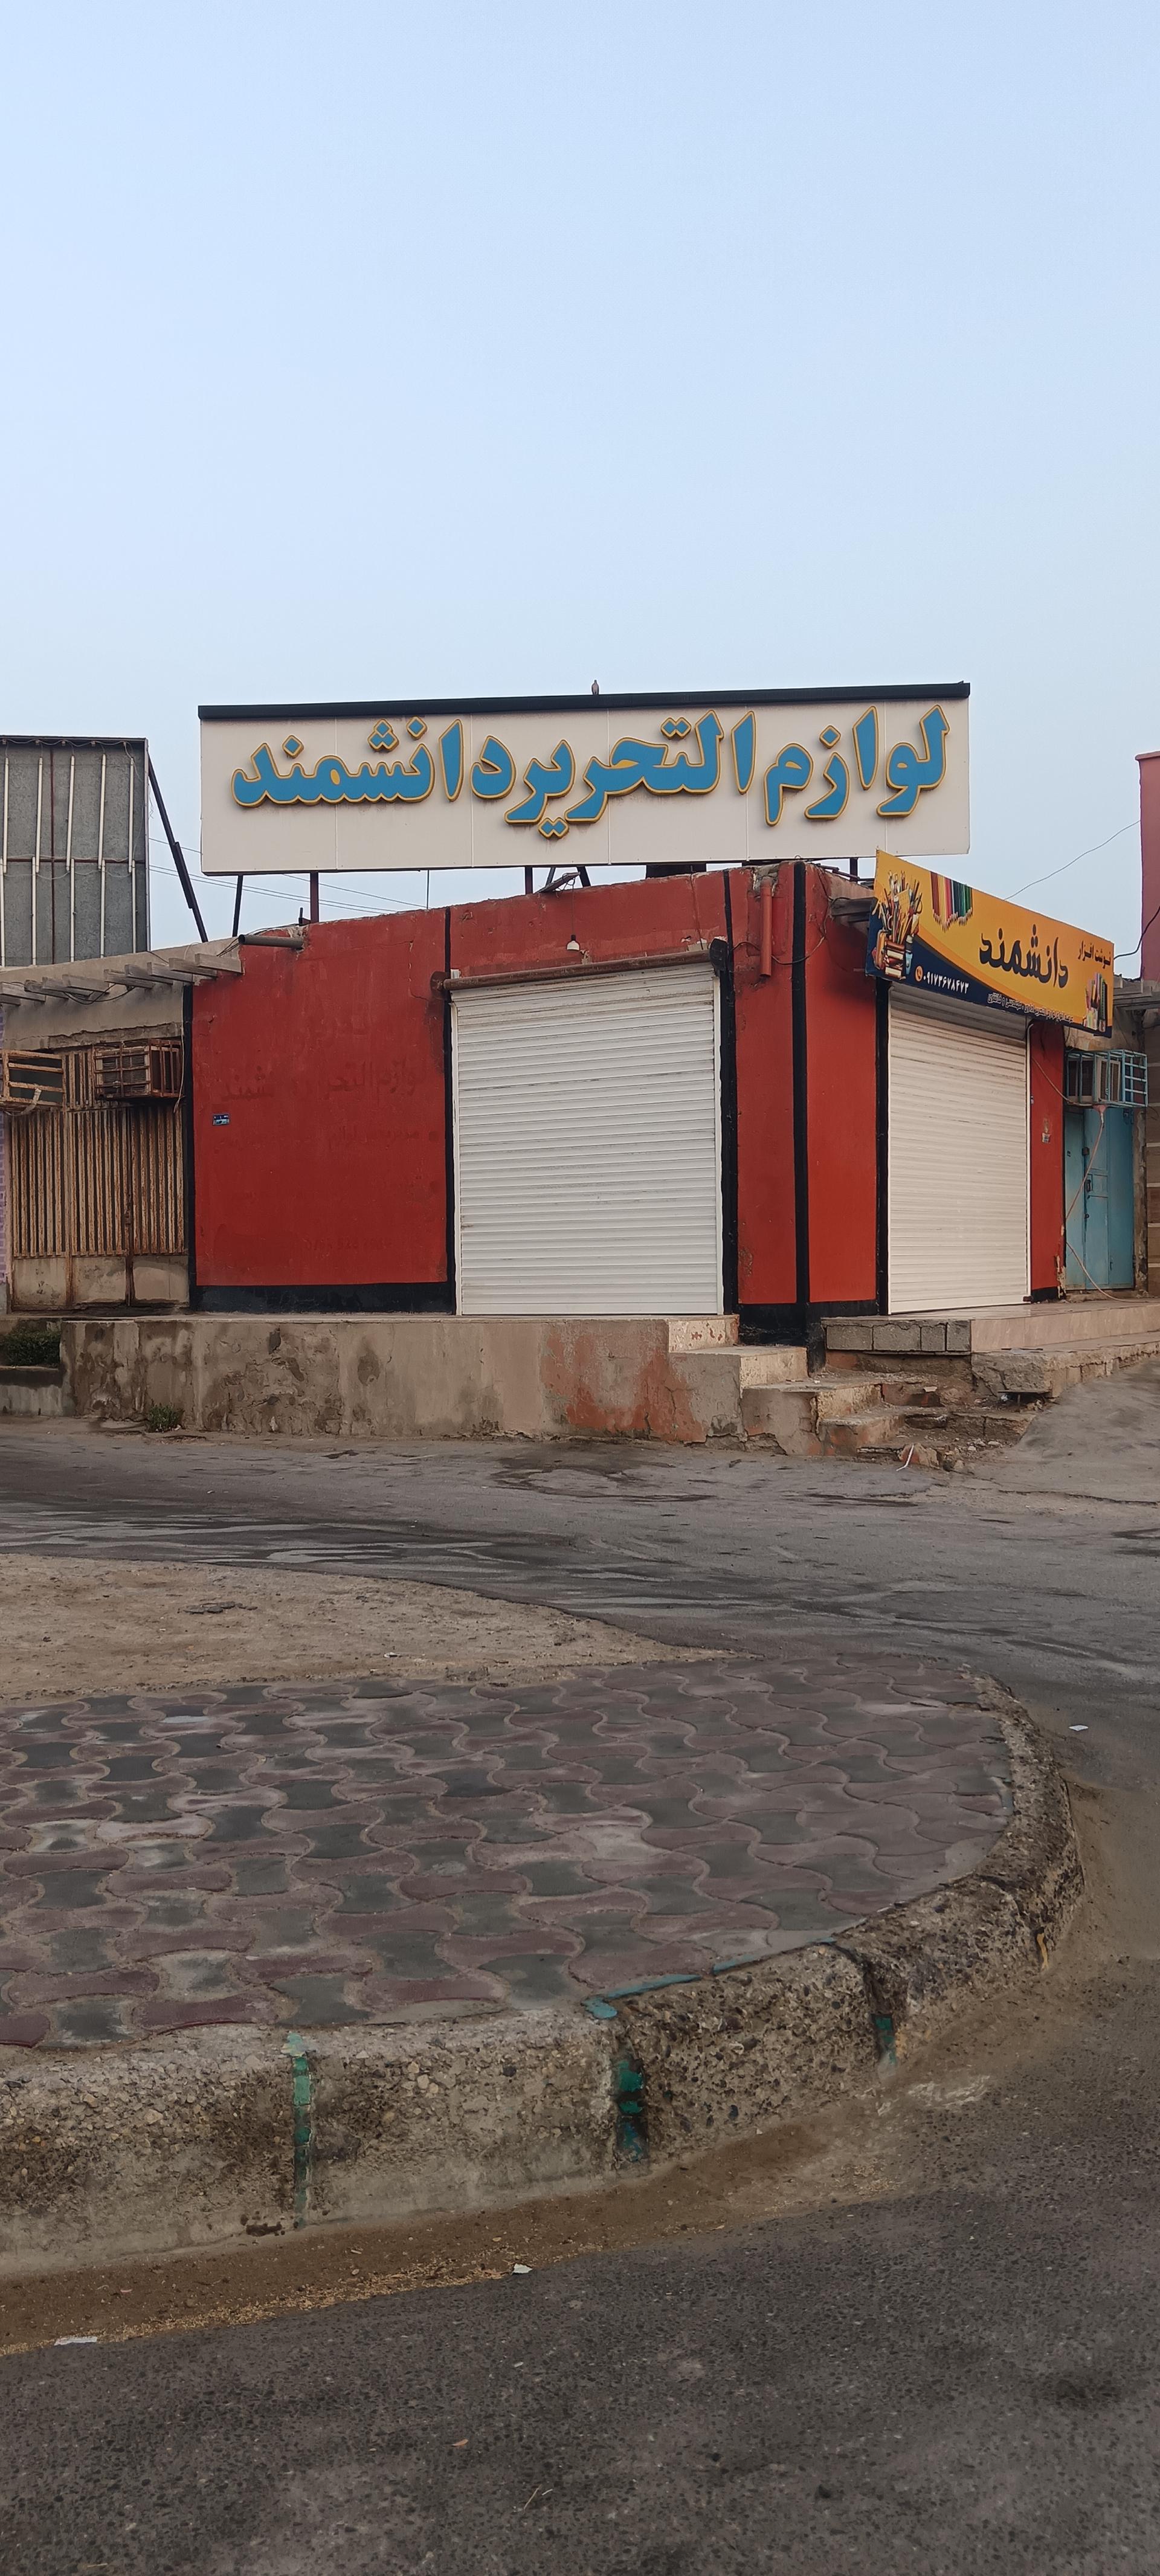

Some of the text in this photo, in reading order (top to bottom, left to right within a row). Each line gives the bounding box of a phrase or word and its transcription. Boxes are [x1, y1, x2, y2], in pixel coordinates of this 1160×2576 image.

[231, 704, 950, 839] لوازم التحریر دانشمند
[979, 924, 1069, 990] دانشمند
[1078, 940, 1112, 969] نوشت افزار
[923, 971, 969, 994] ۰۹۱۷۳۶۷۸۴۷۳
